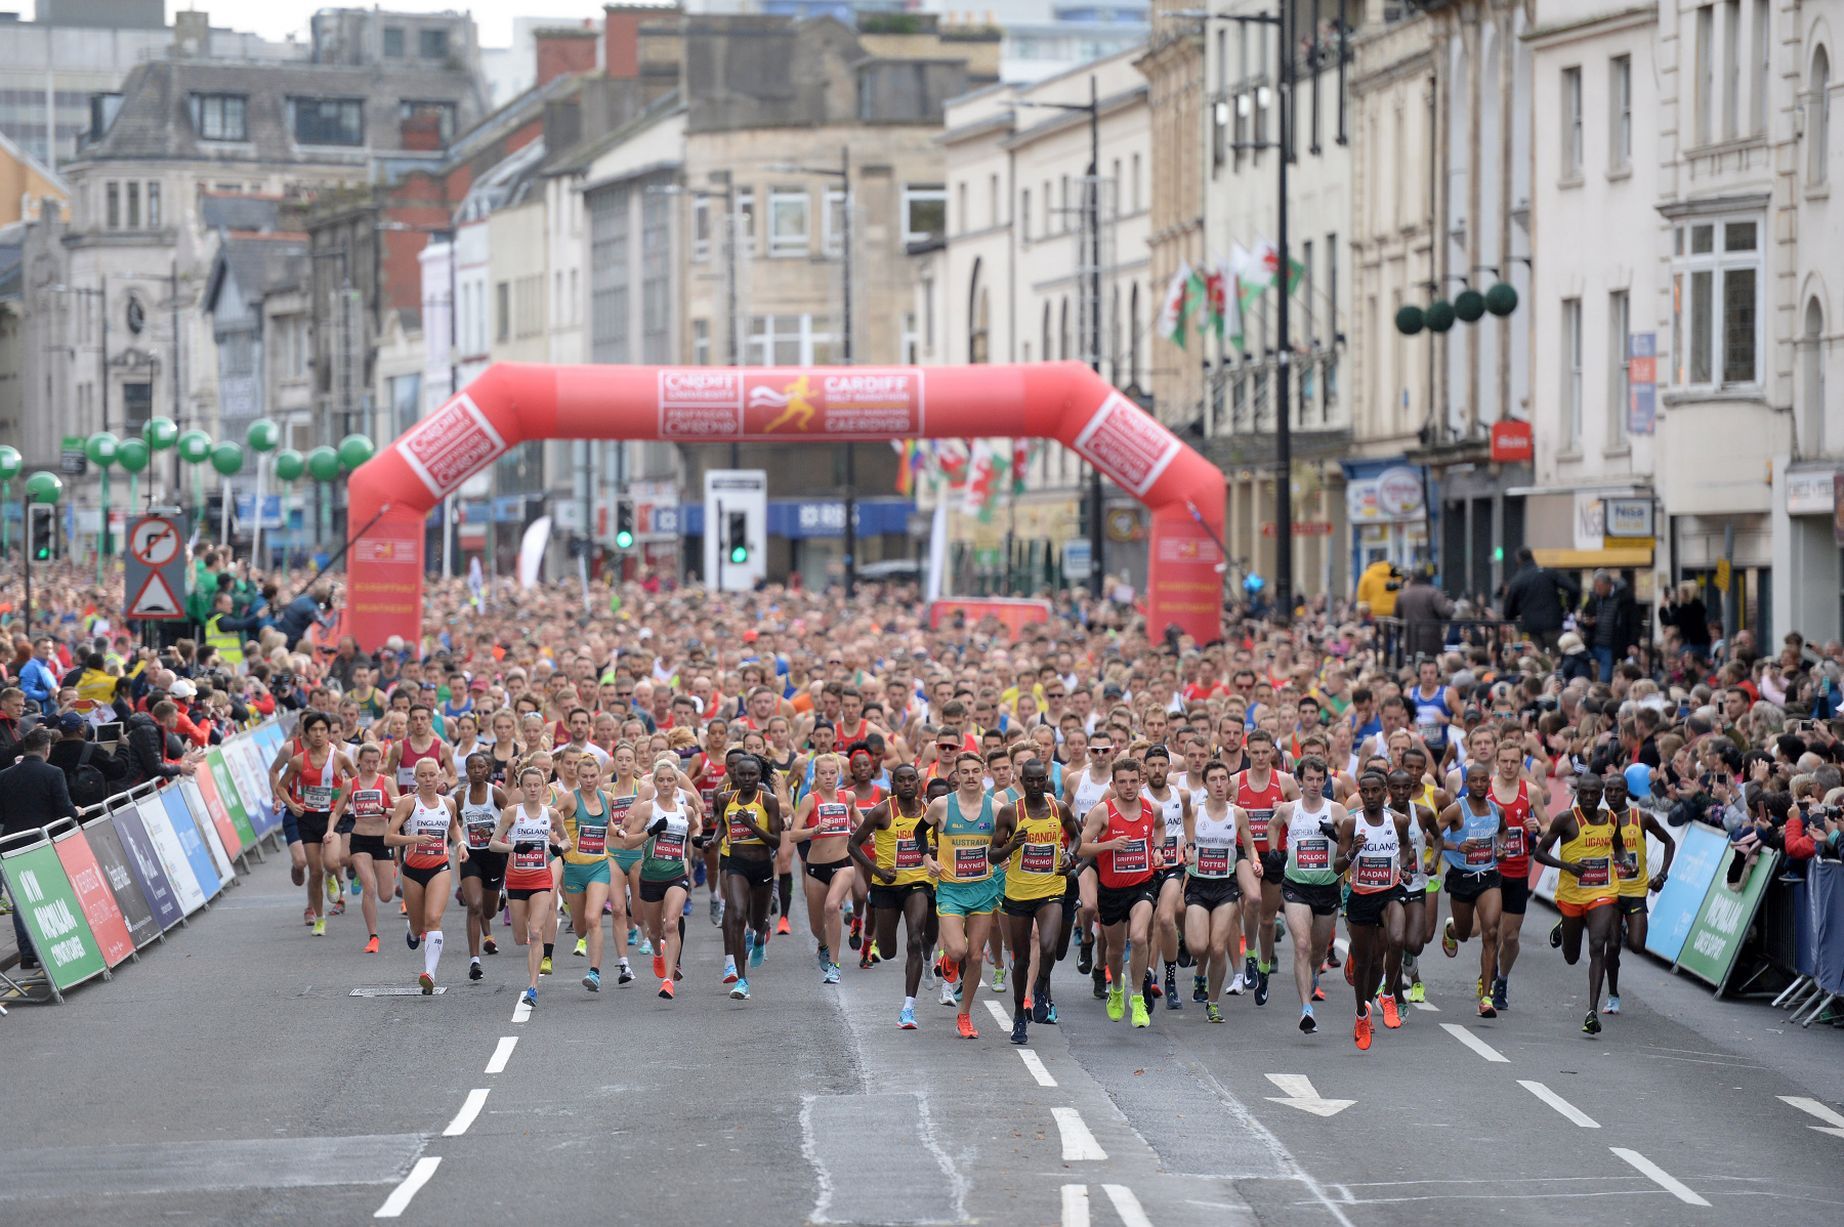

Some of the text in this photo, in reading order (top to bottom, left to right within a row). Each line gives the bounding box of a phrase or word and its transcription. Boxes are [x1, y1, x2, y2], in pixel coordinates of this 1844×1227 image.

[824, 376, 908, 392] CARDIFF
[1616, 506, 1644, 516] Nisa
[1363, 843, 1396, 851] NGLAND
[958, 861, 985, 869] RAYNER
